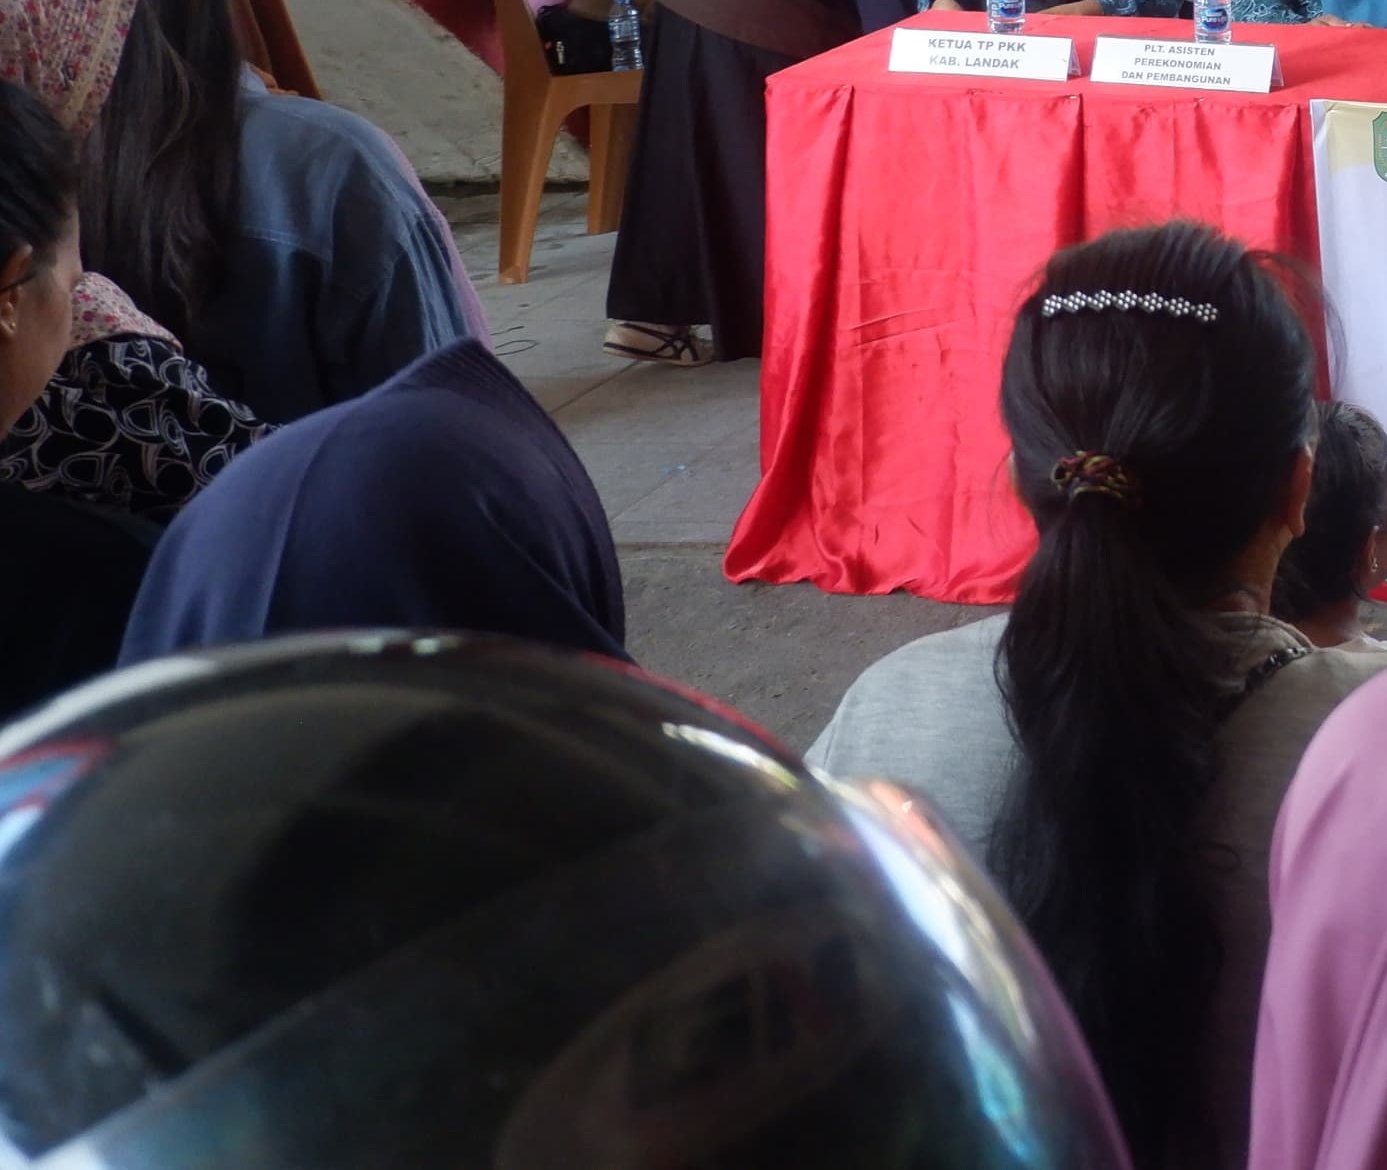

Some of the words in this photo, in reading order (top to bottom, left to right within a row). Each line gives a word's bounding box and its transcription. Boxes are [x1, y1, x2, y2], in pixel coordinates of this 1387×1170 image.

[928, 38, 972, 50] KETUA
[977, 40, 994, 51] TP
[998, 41, 1027, 52] PKK
[1144, 44, 1165, 54] PLT.
[1168, 45, 1215, 56] ASISTEN
[929, 54, 960, 66] KAB.
[965, 57, 1019, 69] LANDAK
[1134, 57, 1221, 70] PEREKONOMIAN
[1121, 70, 1143, 80] DAN
[1147, 72, 1231, 85] PEMBANGUNAN
